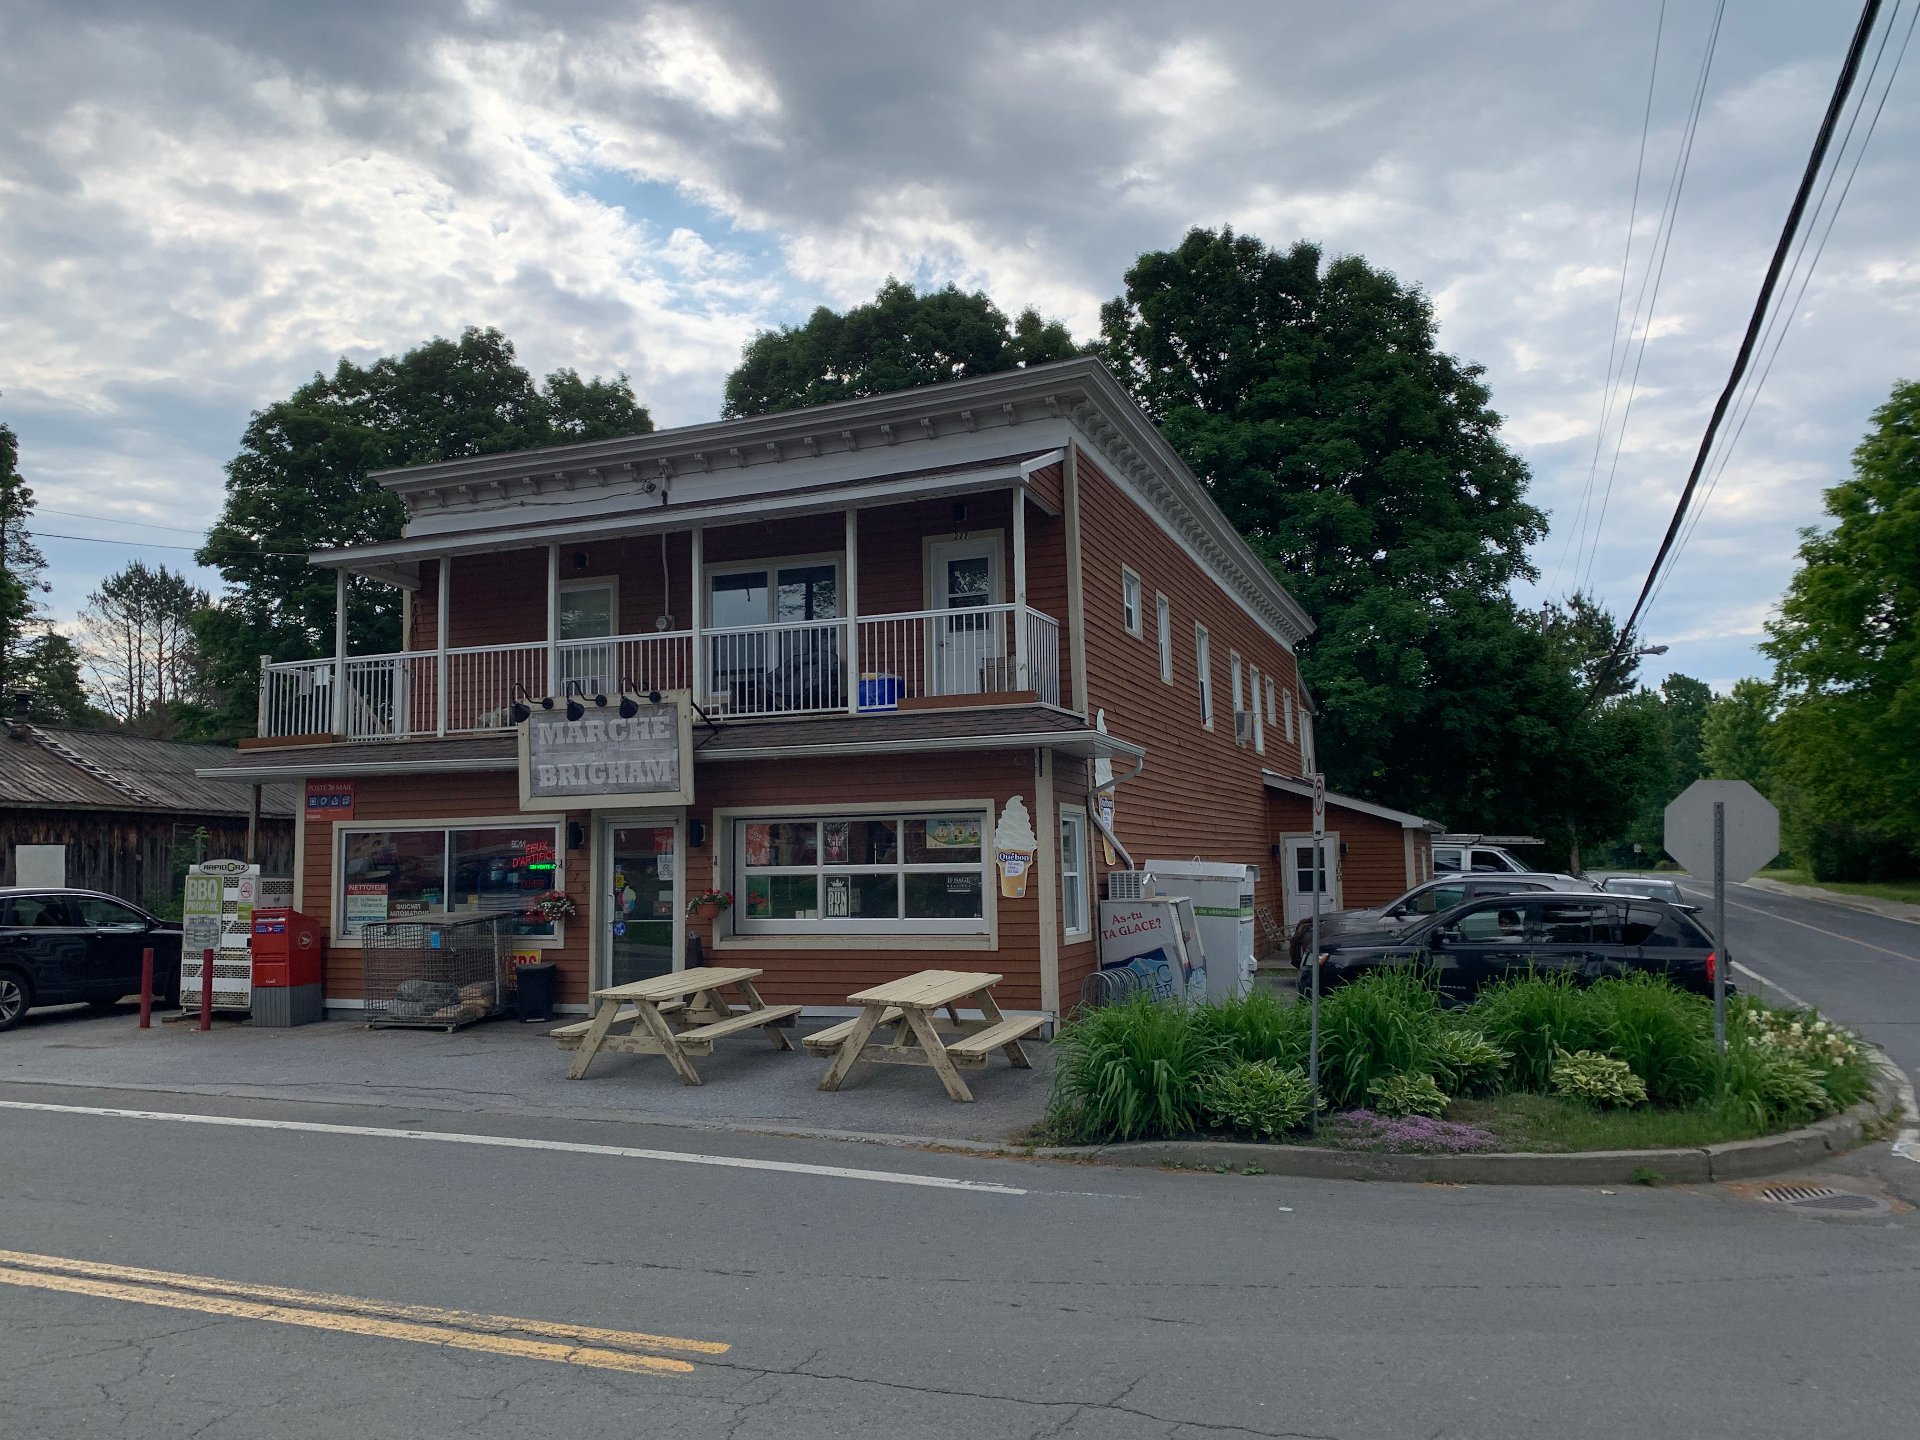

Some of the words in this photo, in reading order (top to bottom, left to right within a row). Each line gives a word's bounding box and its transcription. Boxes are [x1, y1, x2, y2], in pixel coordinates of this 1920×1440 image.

[537, 709, 671, 745] MARCHÉ
[538, 759, 673, 787] BRIGHAM
[525, 842, 548, 853] FEUX
[999, 852, 1030, 862] Québon
[187, 879, 218, 901] BBQ
[828, 892, 847, 904] DUN
[186, 901, 220, 912] PROPANE
[828, 904, 847, 916] HAM
[1111, 910, 1143, 925] As-tu
[1102, 930, 1117, 940] TA
[1118, 917, 1162, 937] GLACE?
